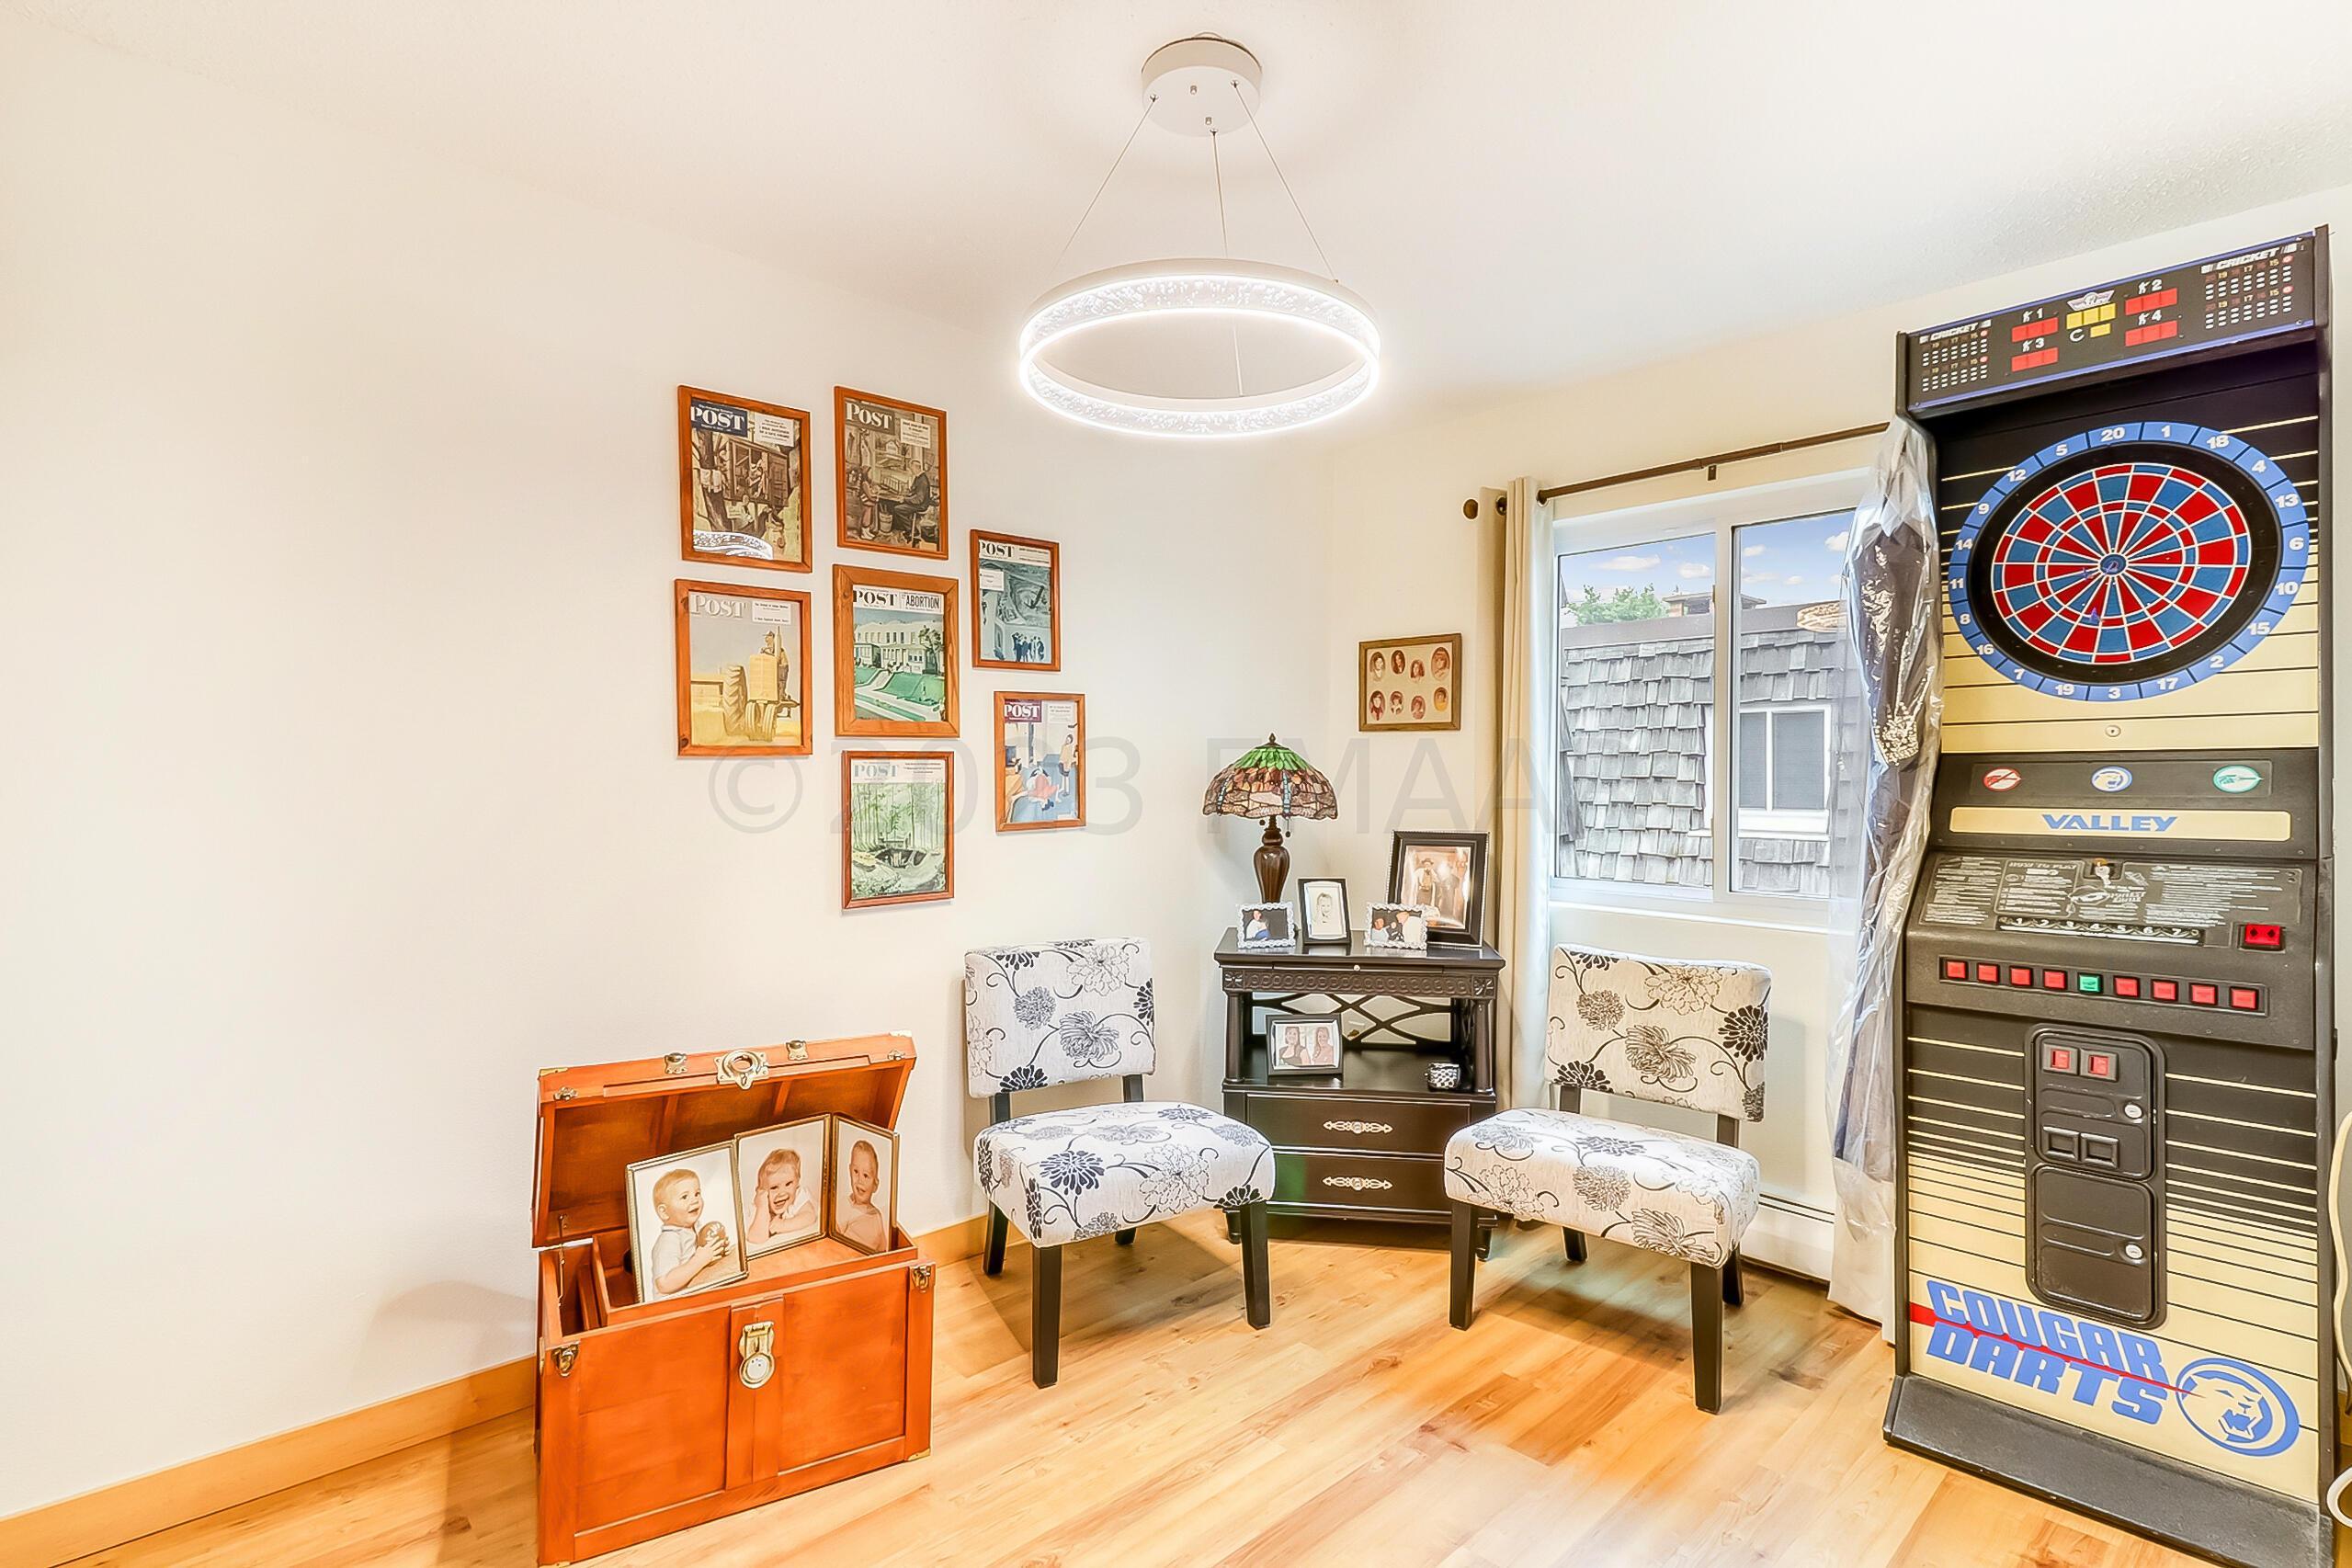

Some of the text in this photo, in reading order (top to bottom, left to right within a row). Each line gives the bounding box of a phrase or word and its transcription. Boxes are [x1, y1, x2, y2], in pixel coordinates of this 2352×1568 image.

[2216, 247, 2280, 270] CRICKET
[2151, 278, 2163, 291] 2
[2036, 308, 2044, 319] 1
[2151, 309, 2163, 322] 4
[1931, 323, 1979, 341] CRICKET
[2035, 337, 2045, 348] 3
[690, 405, 745, 431] POST
[846, 403, 892, 430] POST
[2101, 426, 2125, 441] 20
[2161, 426, 2172, 437] 1
[2206, 435, 2230, 449] 18
[2055, 444, 2068, 456] 5
[2252, 460, 2267, 473] 4
[2006, 469, 2027, 482] 12
[2275, 493, 2299, 508] 13
[1978, 503, 1990, 515] 9
[1955, 539, 1974, 550] 14
[2289, 537, 2304, 551] 6
[1949, 578, 1964, 589] 11
[2275, 581, 2299, 596] 10
[853, 590, 898, 607] POST
[905, 595, 939, 609] ABORTION
[691, 595, 746, 618] POST
[1960, 613, 1971, 625] 8
[2248, 621, 2270, 636] 15
[1976, 643, 1994, 655] 16
[2210, 654, 2224, 668] 2
[2014, 668, 2026, 680] 7
[2055, 684, 2074, 696] 19
[2157, 677, 2178, 689] 17
[2108, 687, 2121, 699] 3
[1004, 704, 1040, 718] POST
[854, 764, 899, 778] POST
[2041, 813, 2178, 832] VALLEY
[2067, 920, 2074, 928] 3
[2143, 926, 2153, 934] 6
[2172, 927, 2183, 936] 7
[1926, 1279, 2170, 1385] COUGAR
[1926, 1321, 2169, 1426] DARTS
